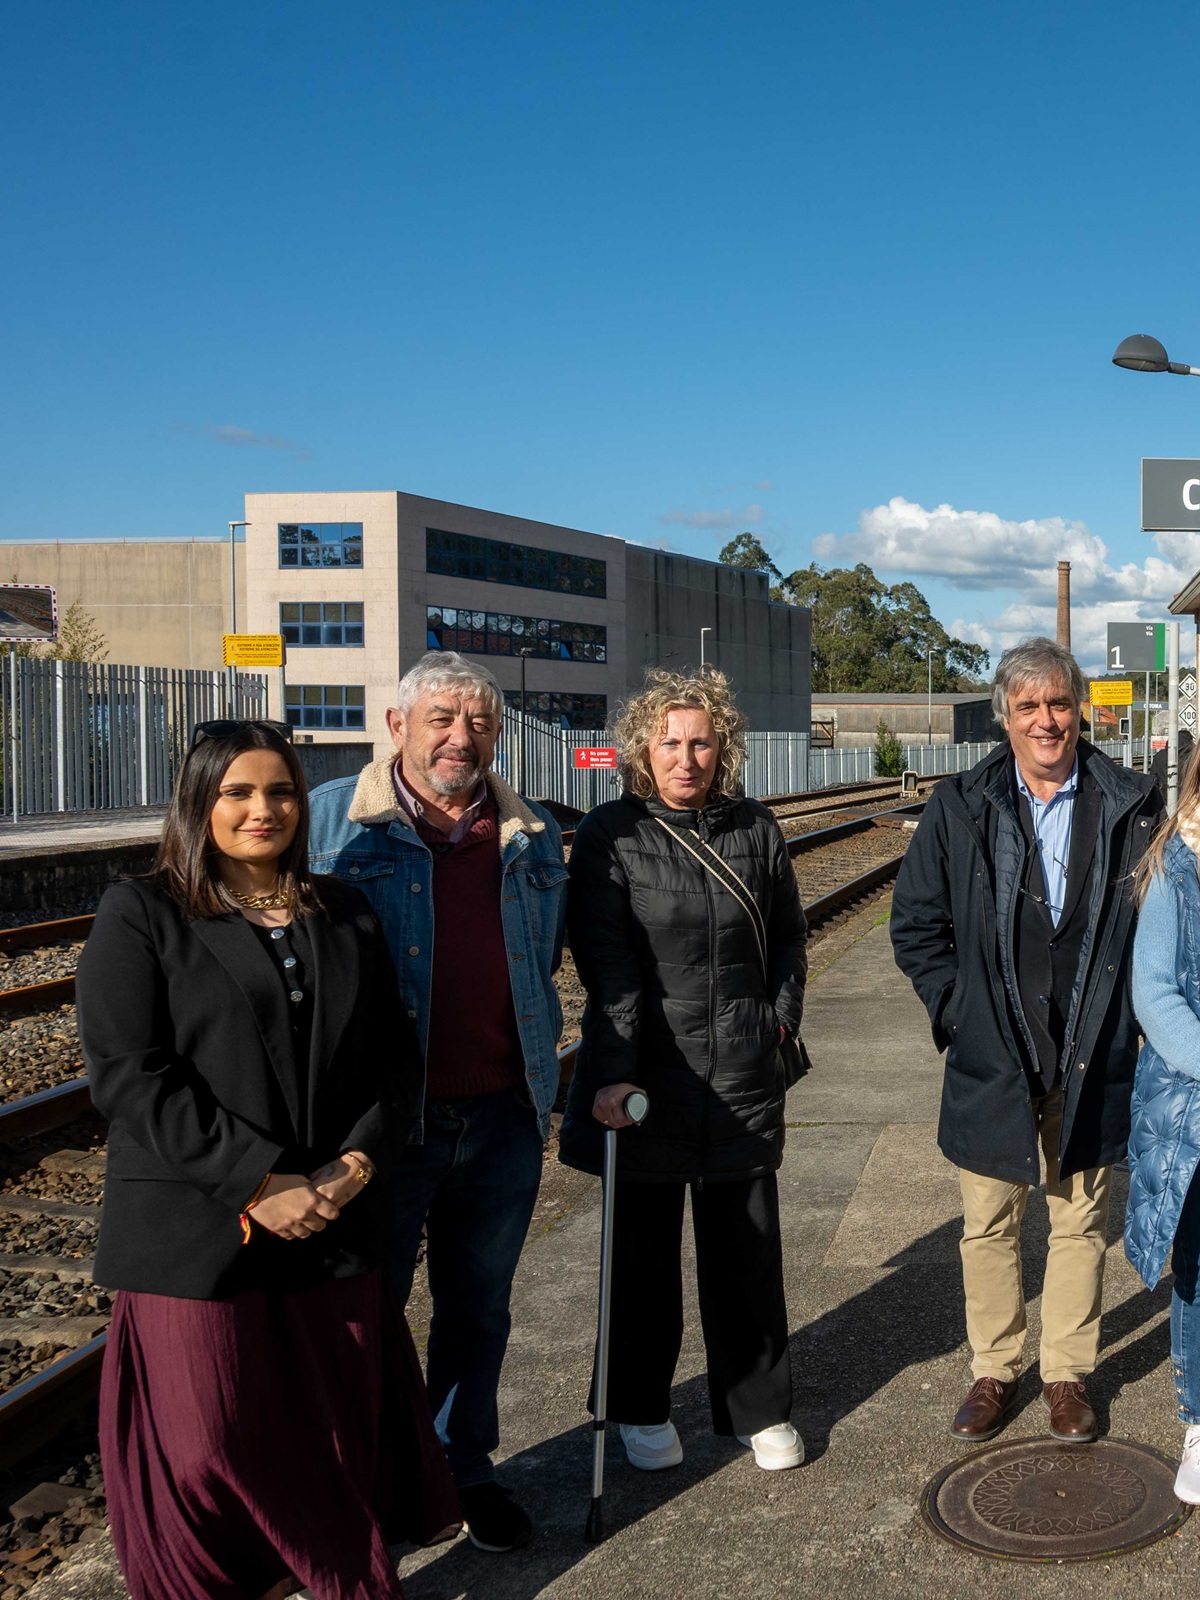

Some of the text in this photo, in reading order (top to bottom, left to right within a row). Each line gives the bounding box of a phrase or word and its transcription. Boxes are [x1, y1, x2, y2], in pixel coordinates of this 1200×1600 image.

[1110, 646, 1125, 668] 1
[1185, 682, 1195, 691] 30
[1183, 711, 1196, 720] 100
